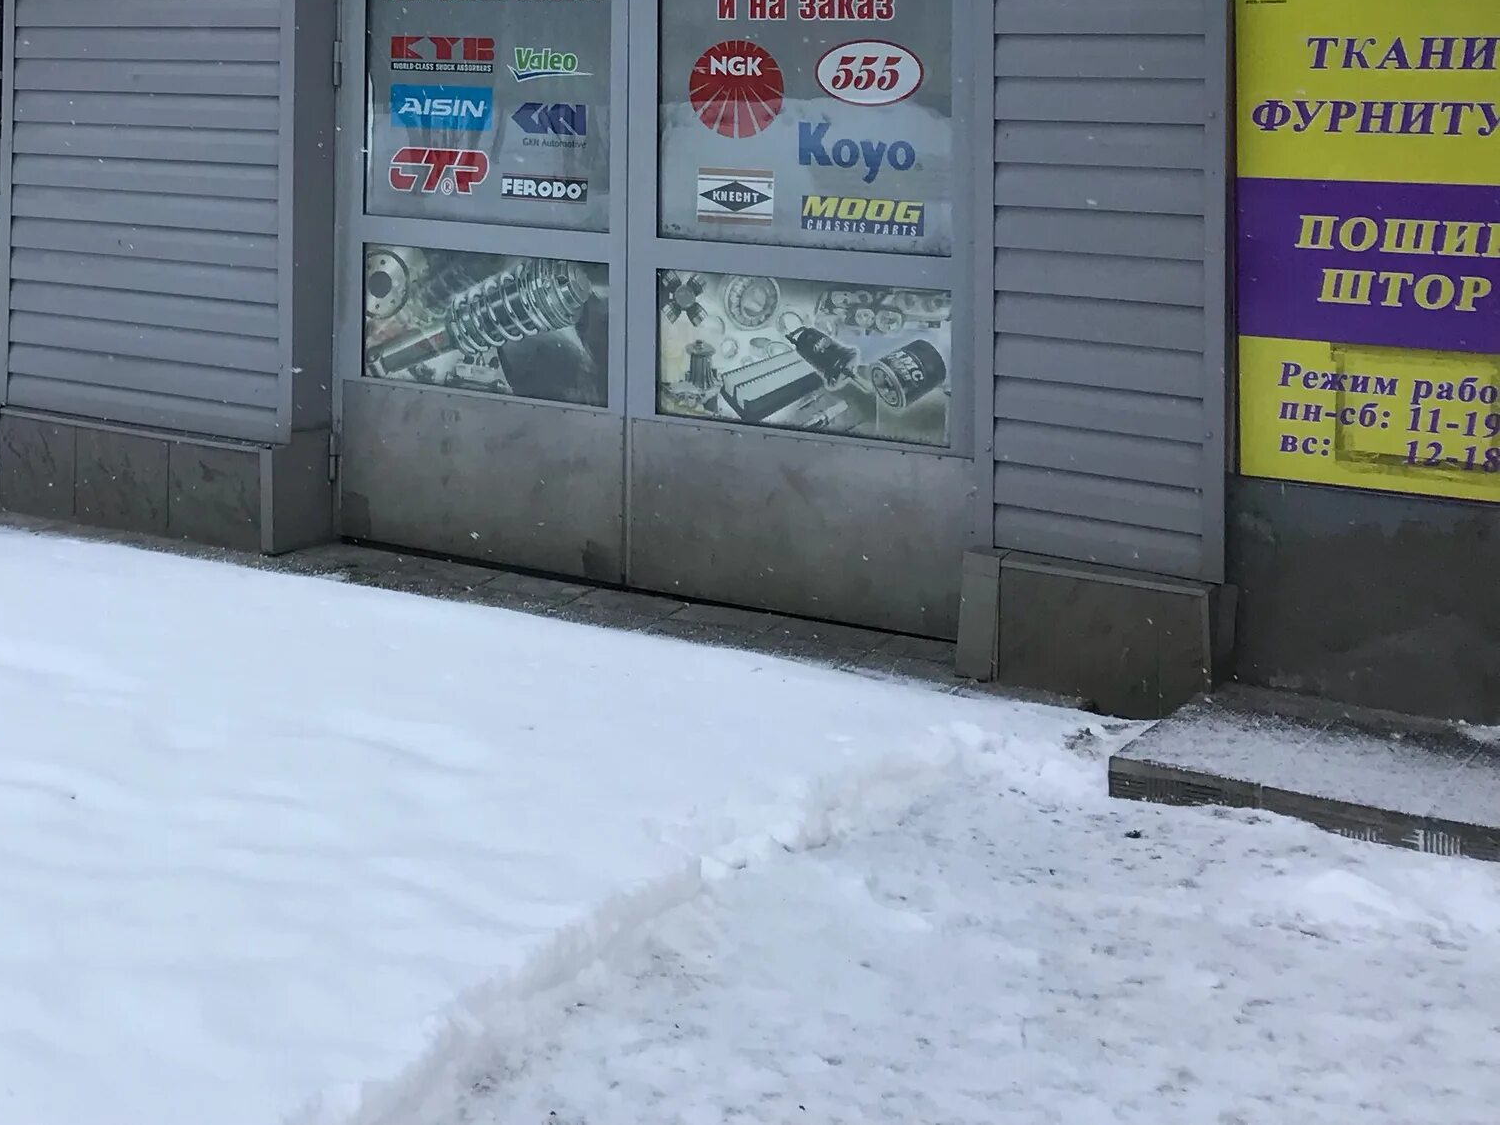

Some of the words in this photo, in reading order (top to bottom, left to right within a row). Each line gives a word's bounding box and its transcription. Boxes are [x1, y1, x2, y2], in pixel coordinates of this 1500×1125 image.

[391, 36, 495, 61] KYB
[514, 47, 578, 73] Valeo
[1307, 36, 1500, 70] ТКАНИ
[710, 55, 763, 77] NGK
[831, 56, 902, 90] 555
[398, 97, 485, 117] AISIN
[1252, 100, 1500, 136] ФУРНИТУ
[541, 139, 587, 149] Automotive
[798, 122, 916, 184] Koyo
[501, 178, 582, 200] FERODO
[712, 191, 760, 204] KNECHT
[802, 196, 924, 224] MOOG
[806, 219, 867, 233] CHASSIS
[874, 223, 918, 236] PARTS
[1317, 268, 1492, 312] ШТОР
[1277, 361, 1399, 396] Режим
[1278, 402, 1391, 429] пн-сб:
[1406, 406, 1500, 439] 11-19
[1279, 434, 1331, 456] вс:
[1403, 440, 1500, 473] 12-18
